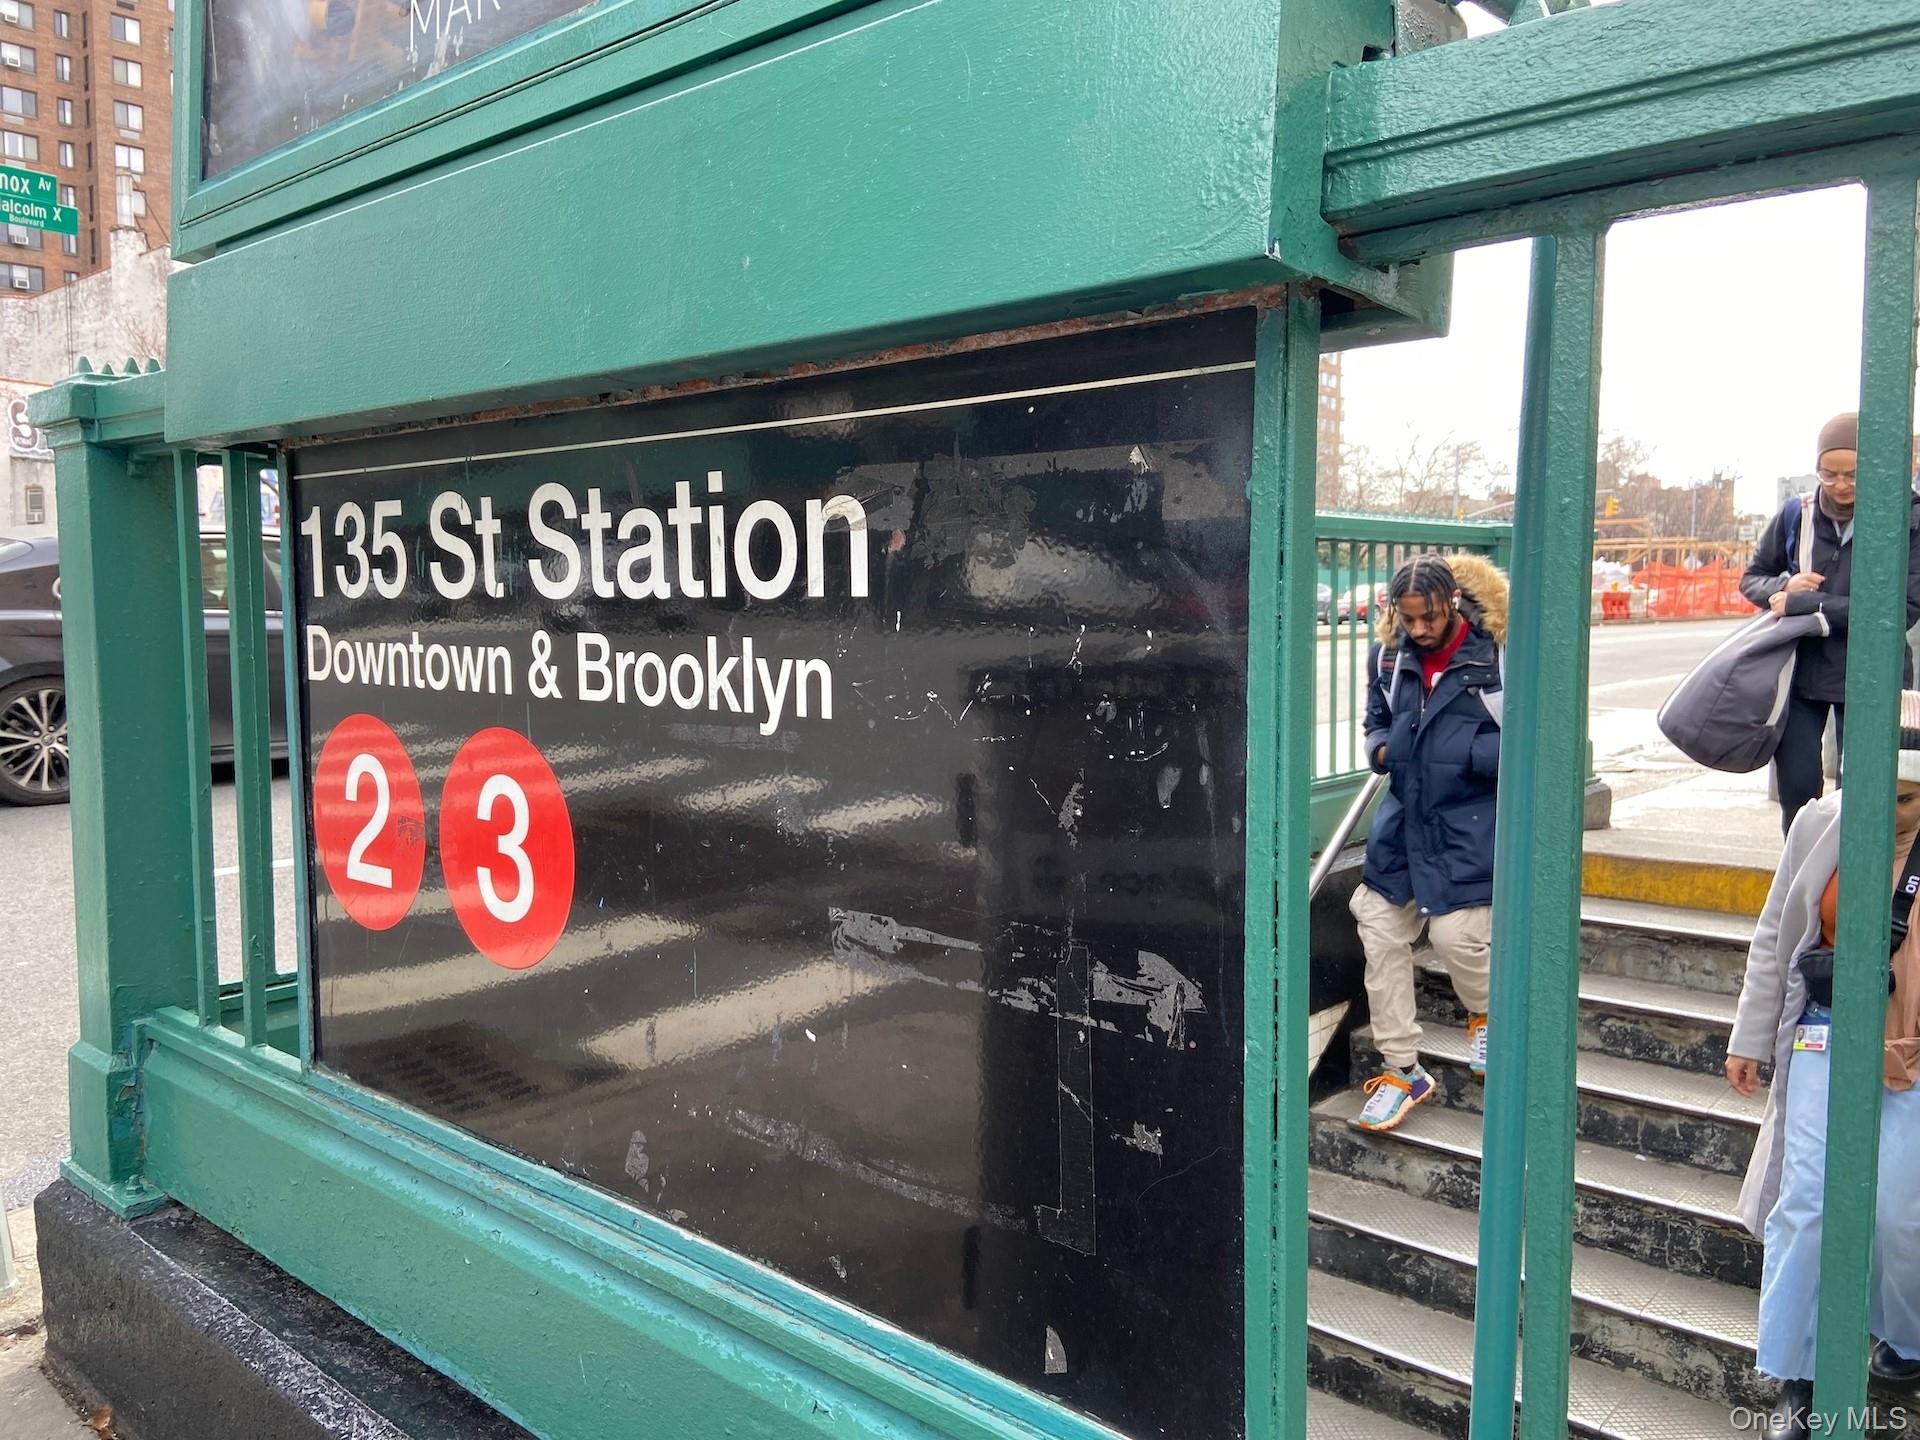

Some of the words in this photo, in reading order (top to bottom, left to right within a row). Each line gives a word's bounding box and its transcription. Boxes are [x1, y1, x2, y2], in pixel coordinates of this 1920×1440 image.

[0, 199, 47, 219] alcolm
[52, 206, 62, 222] X
[38, 176, 52, 191] Av
[9, 213, 45, 228] Boulevard
[300, 499, 408, 600] 135
[429, 490, 504, 600] St
[527, 470, 869, 600] Station
[306, 624, 512, 696] Downtown
[527, 629, 563, 699] &
[576, 631, 833, 736] Brooklyn
[345, 753, 393, 889] 2
[476, 773, 535, 923] 3
